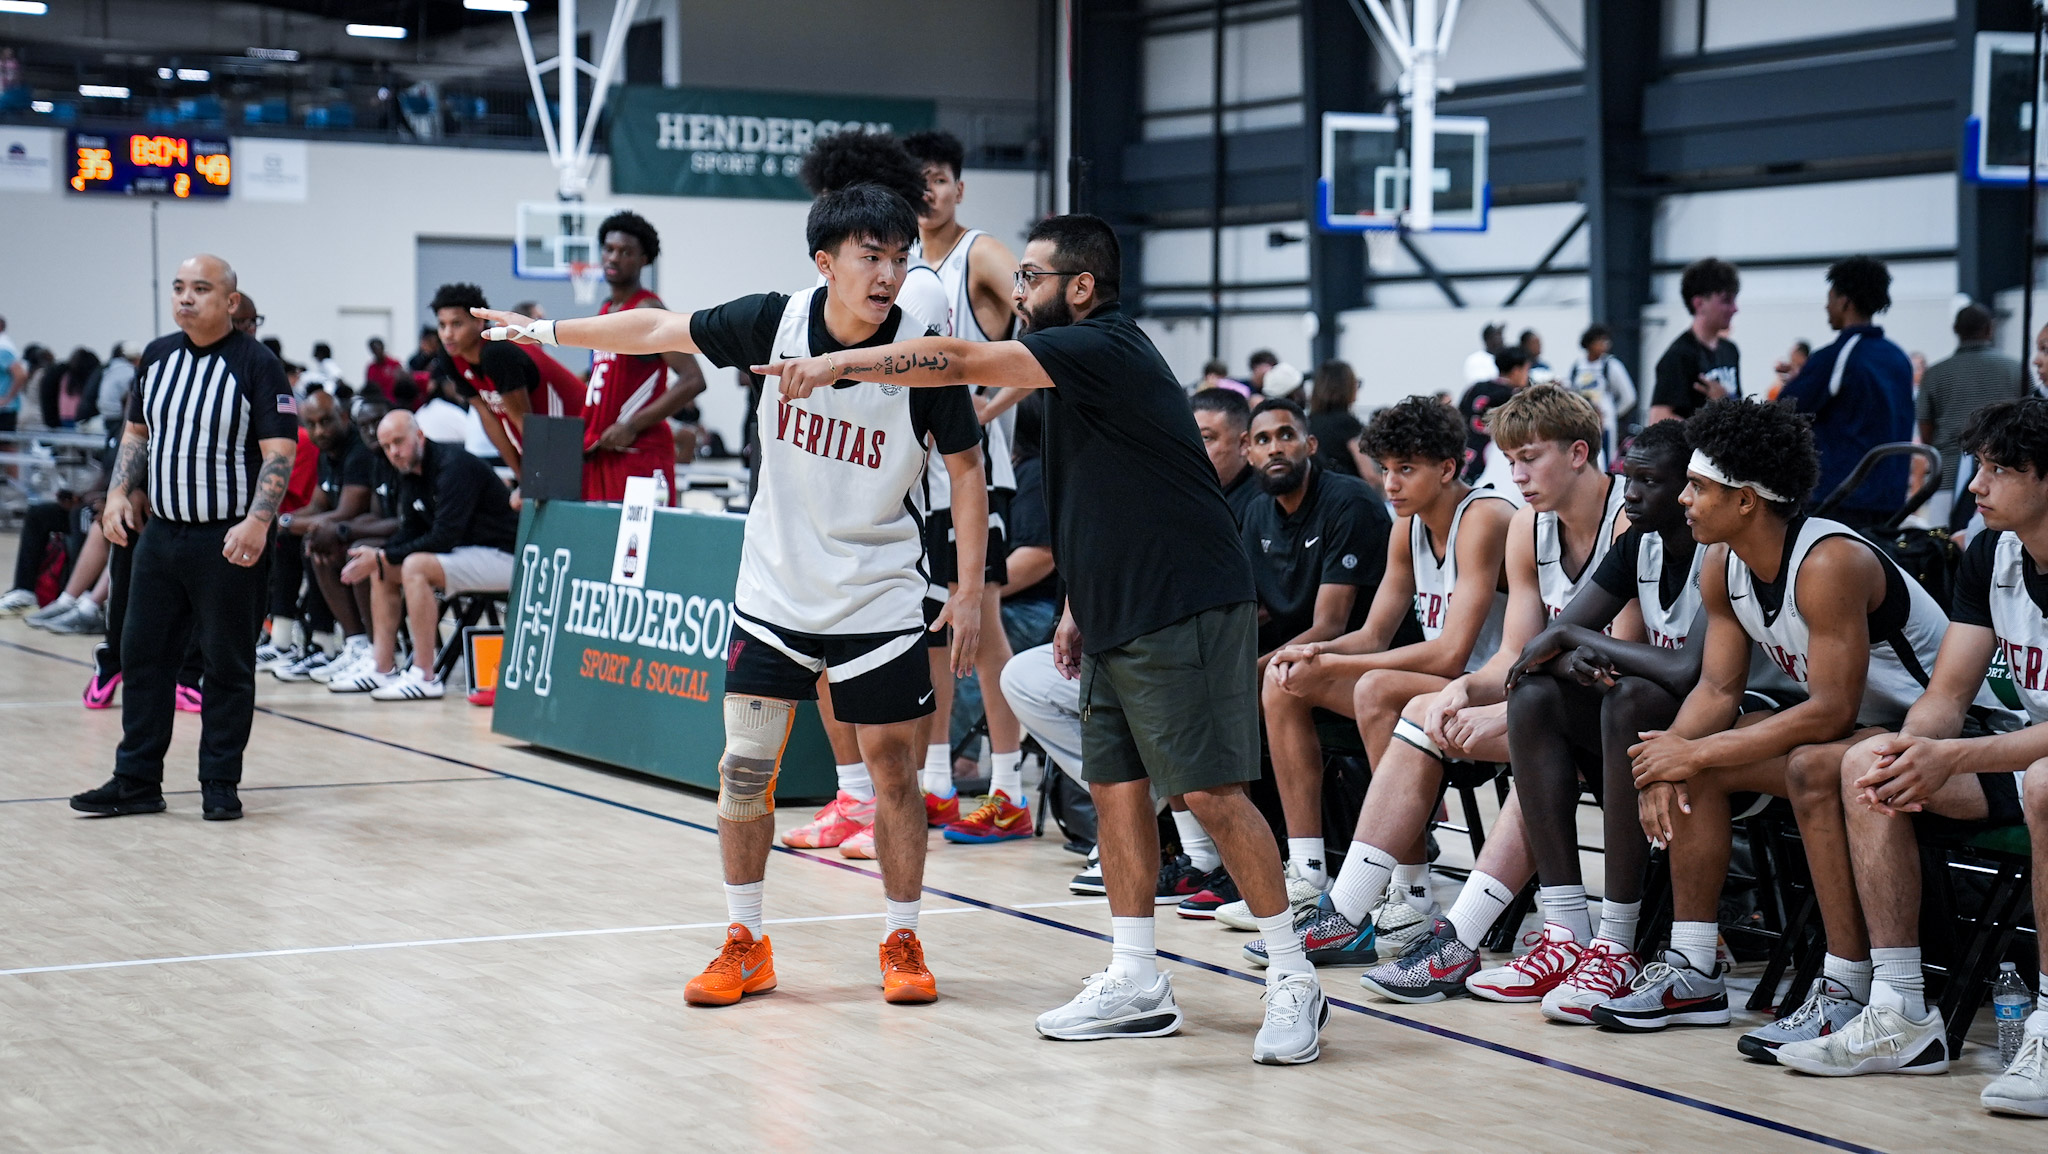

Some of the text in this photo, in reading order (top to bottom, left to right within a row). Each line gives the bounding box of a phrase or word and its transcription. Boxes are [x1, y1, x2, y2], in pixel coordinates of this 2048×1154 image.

[77, 148, 113, 180] 35
[195, 154, 230, 185] 49
[691, 151, 759, 176] SPORT
[776, 400, 886, 469] VERITAS
[579, 648, 710, 702] SPORT & SOCIAL
